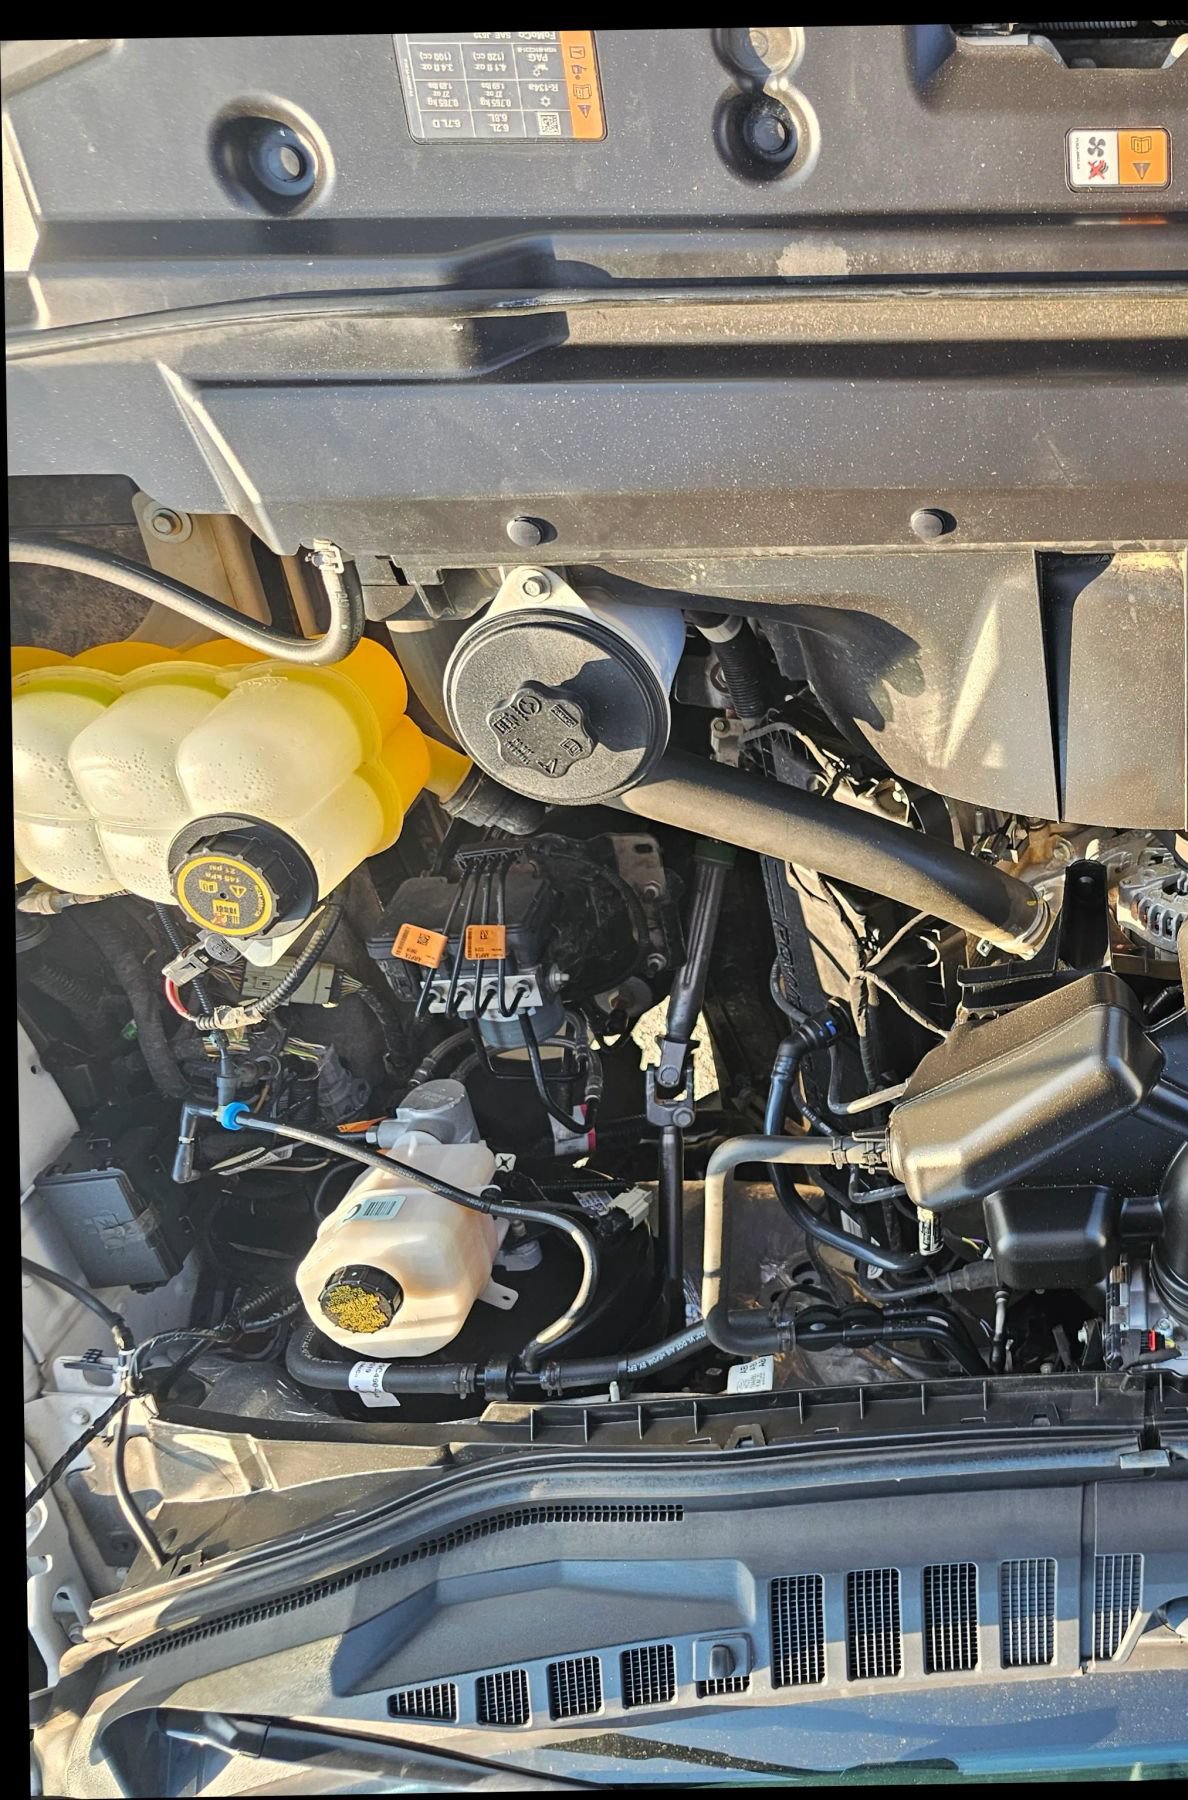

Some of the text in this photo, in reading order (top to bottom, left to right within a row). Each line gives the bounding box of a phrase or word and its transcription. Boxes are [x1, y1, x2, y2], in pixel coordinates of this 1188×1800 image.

[518, 32, 556, 40] FoMoCo
[487, 52, 504, 61] (120
[440, 64, 454, 72] 3.4
[495, 64, 506, 72] 4.1
[528, 83, 558, 92] R-134a
[480, 96, 490, 106] kg
[433, 120, 460, 128] 6.7L D
[488, 124, 509, 132] 6.2L
